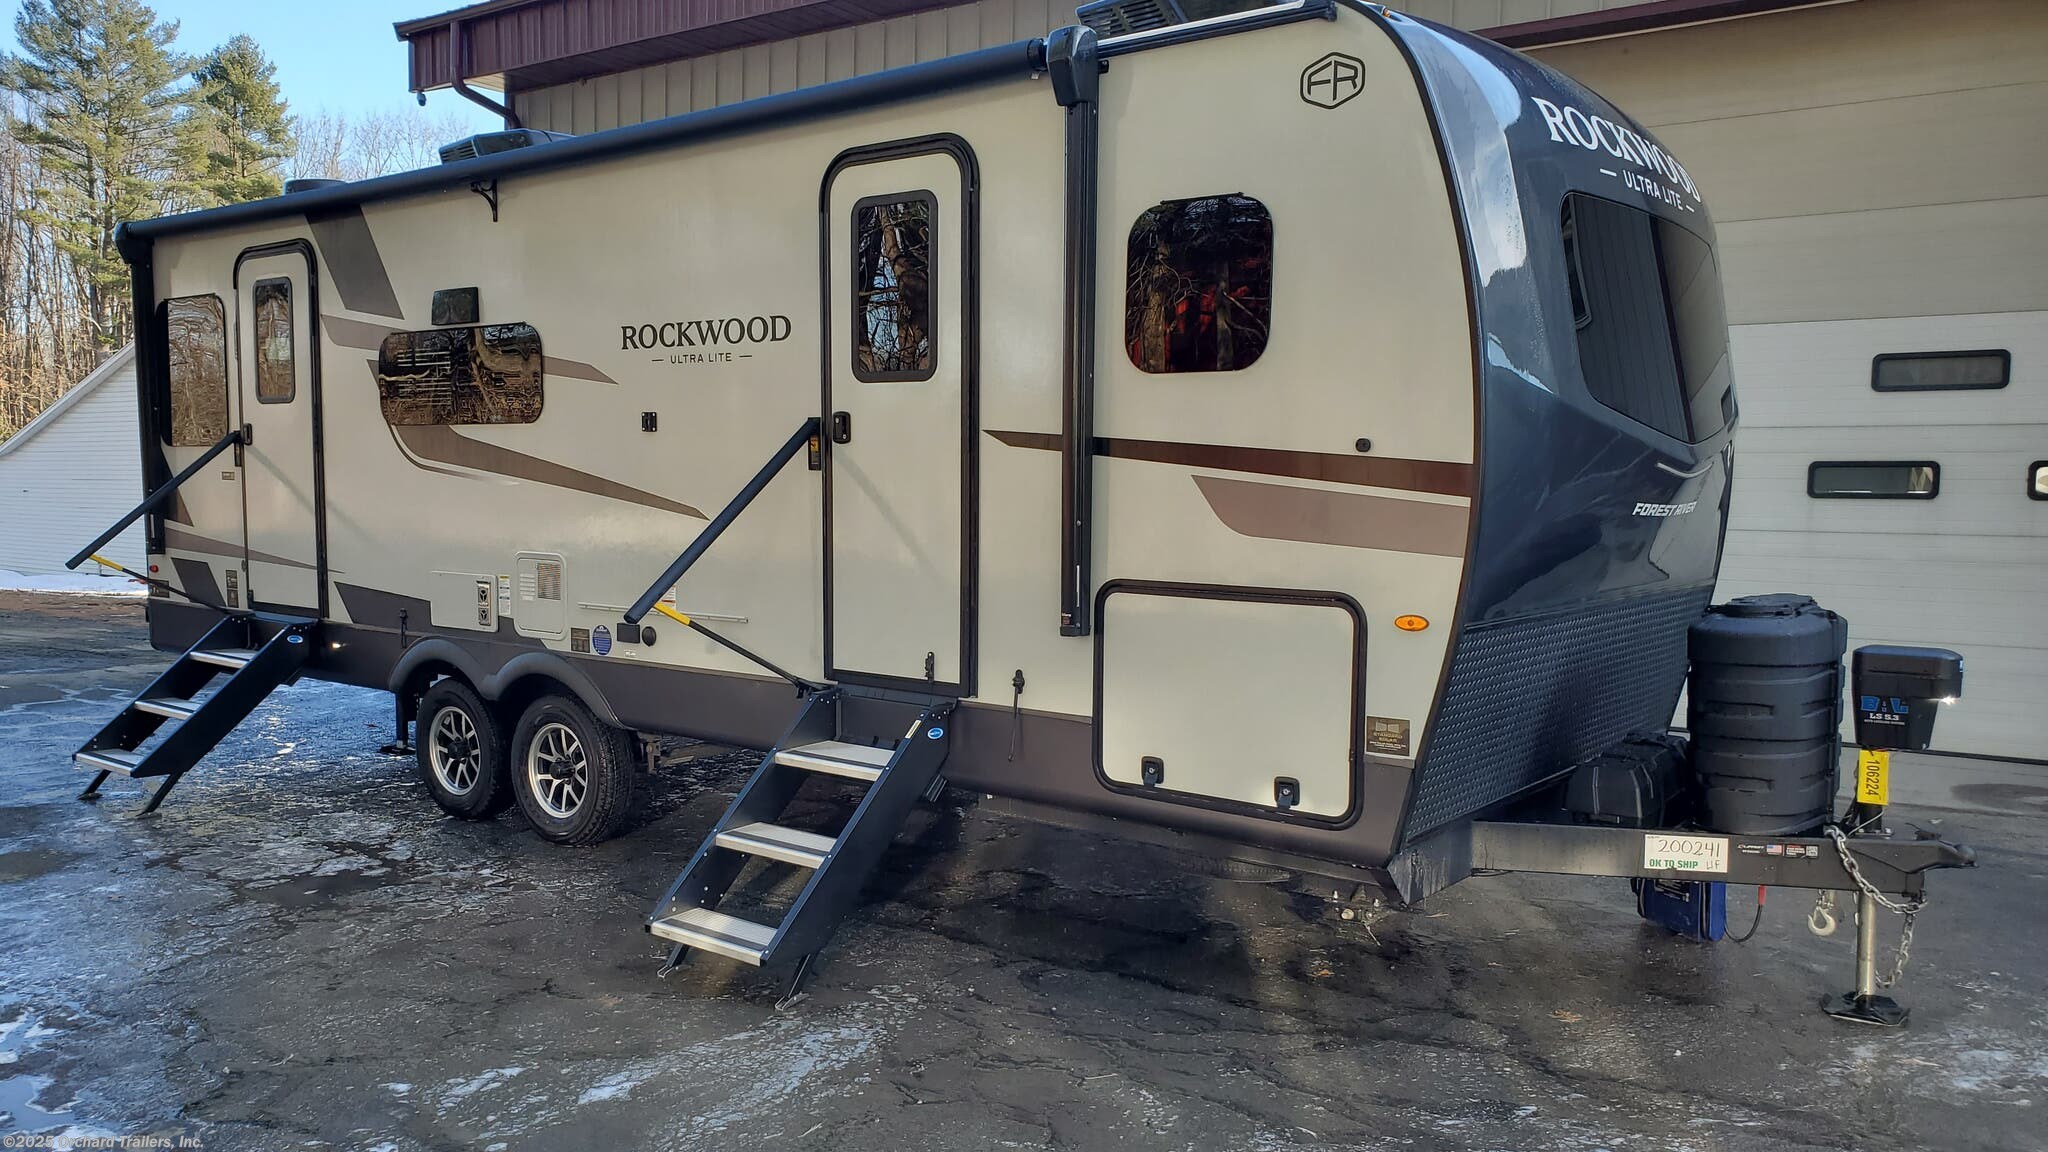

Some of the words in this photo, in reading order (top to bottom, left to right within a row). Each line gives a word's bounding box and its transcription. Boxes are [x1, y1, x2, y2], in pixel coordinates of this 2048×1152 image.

[1531, 96, 1701, 202] ROCKWOOD
[1622, 169, 1661, 199] ULTRA
[1661, 185, 1683, 211] LITE
[621, 315, 792, 350] ROCKWOOD
[670, 354, 704, 364] ULTRA
[708, 352, 732, 363] LITE
[1632, 503, 1677, 516] FOREST
[1869, 712, 1882, 720] LS
[1866, 759, 1881, 796] 106224
[1658, 839, 1720, 857] 200241
[1649, 858, 1662, 867] OK
[1664, 859, 1675, 868] TO
[1677, 859, 1699, 869] SHIP
